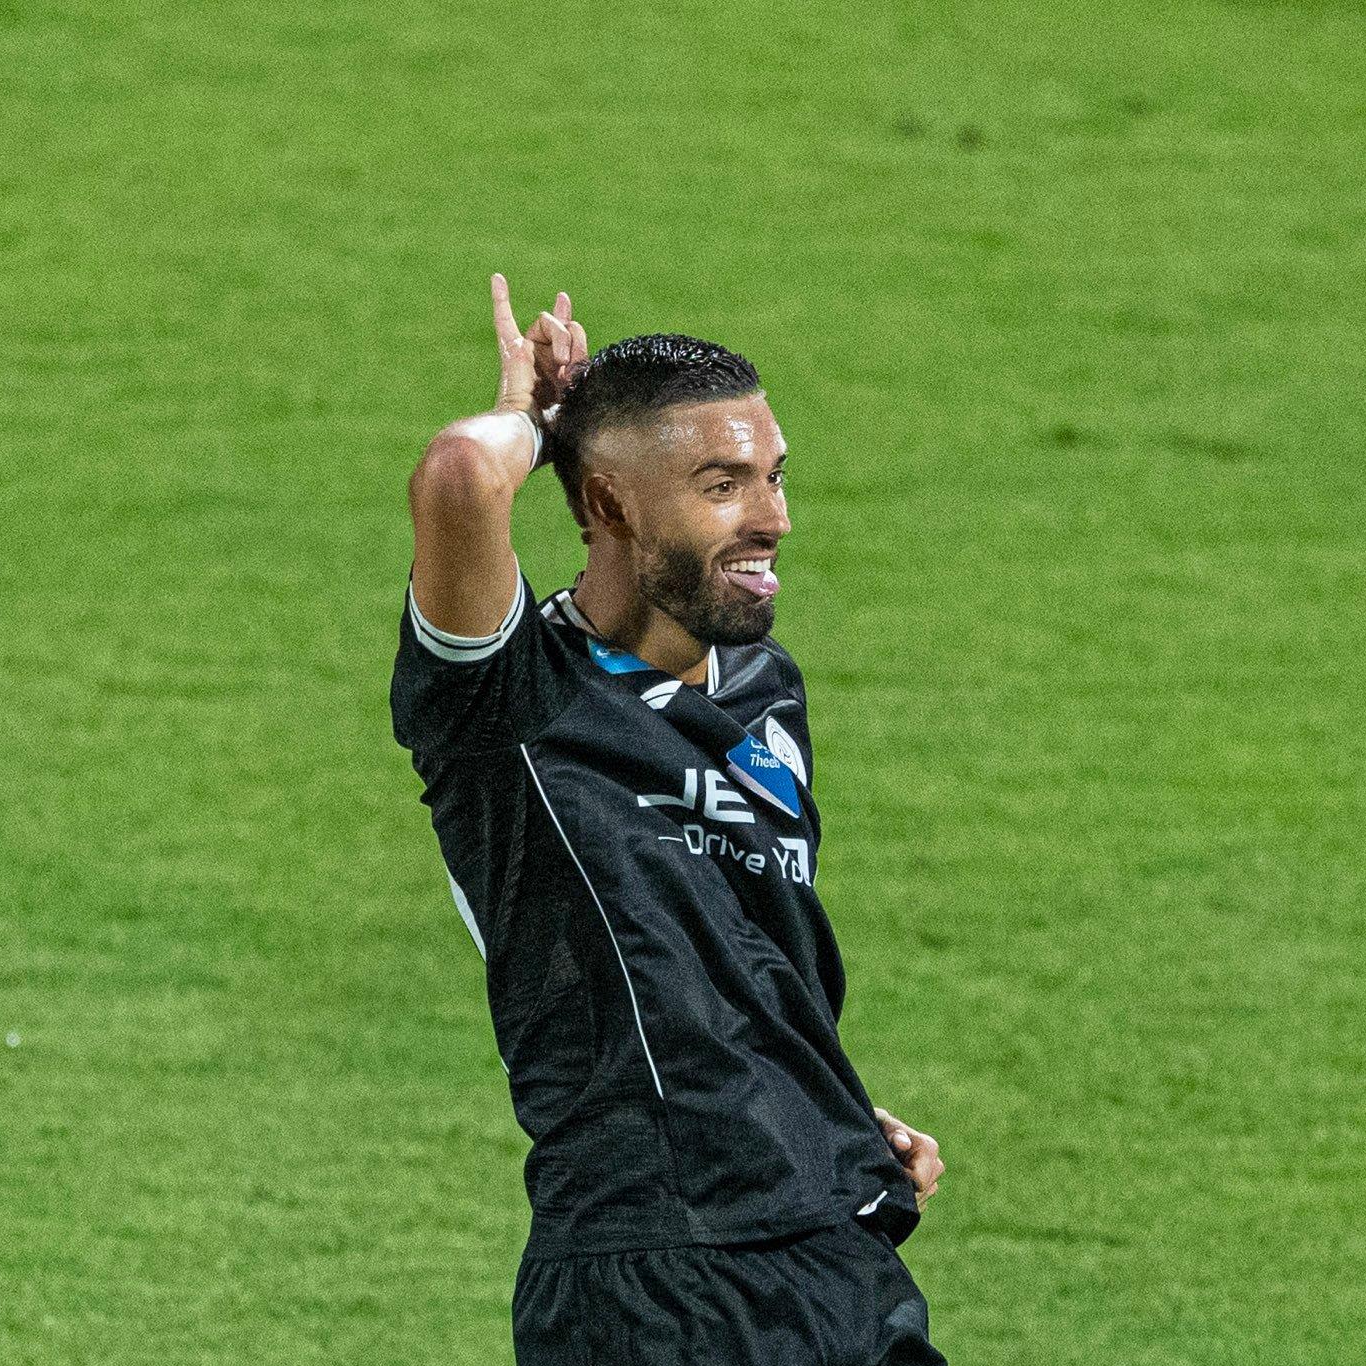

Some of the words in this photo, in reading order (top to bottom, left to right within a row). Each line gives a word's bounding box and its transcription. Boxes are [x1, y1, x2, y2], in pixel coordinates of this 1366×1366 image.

[637, 768, 756, 824] JE
[683, 824, 766, 875] Drive
[771, 847, 812, 887] Yo
